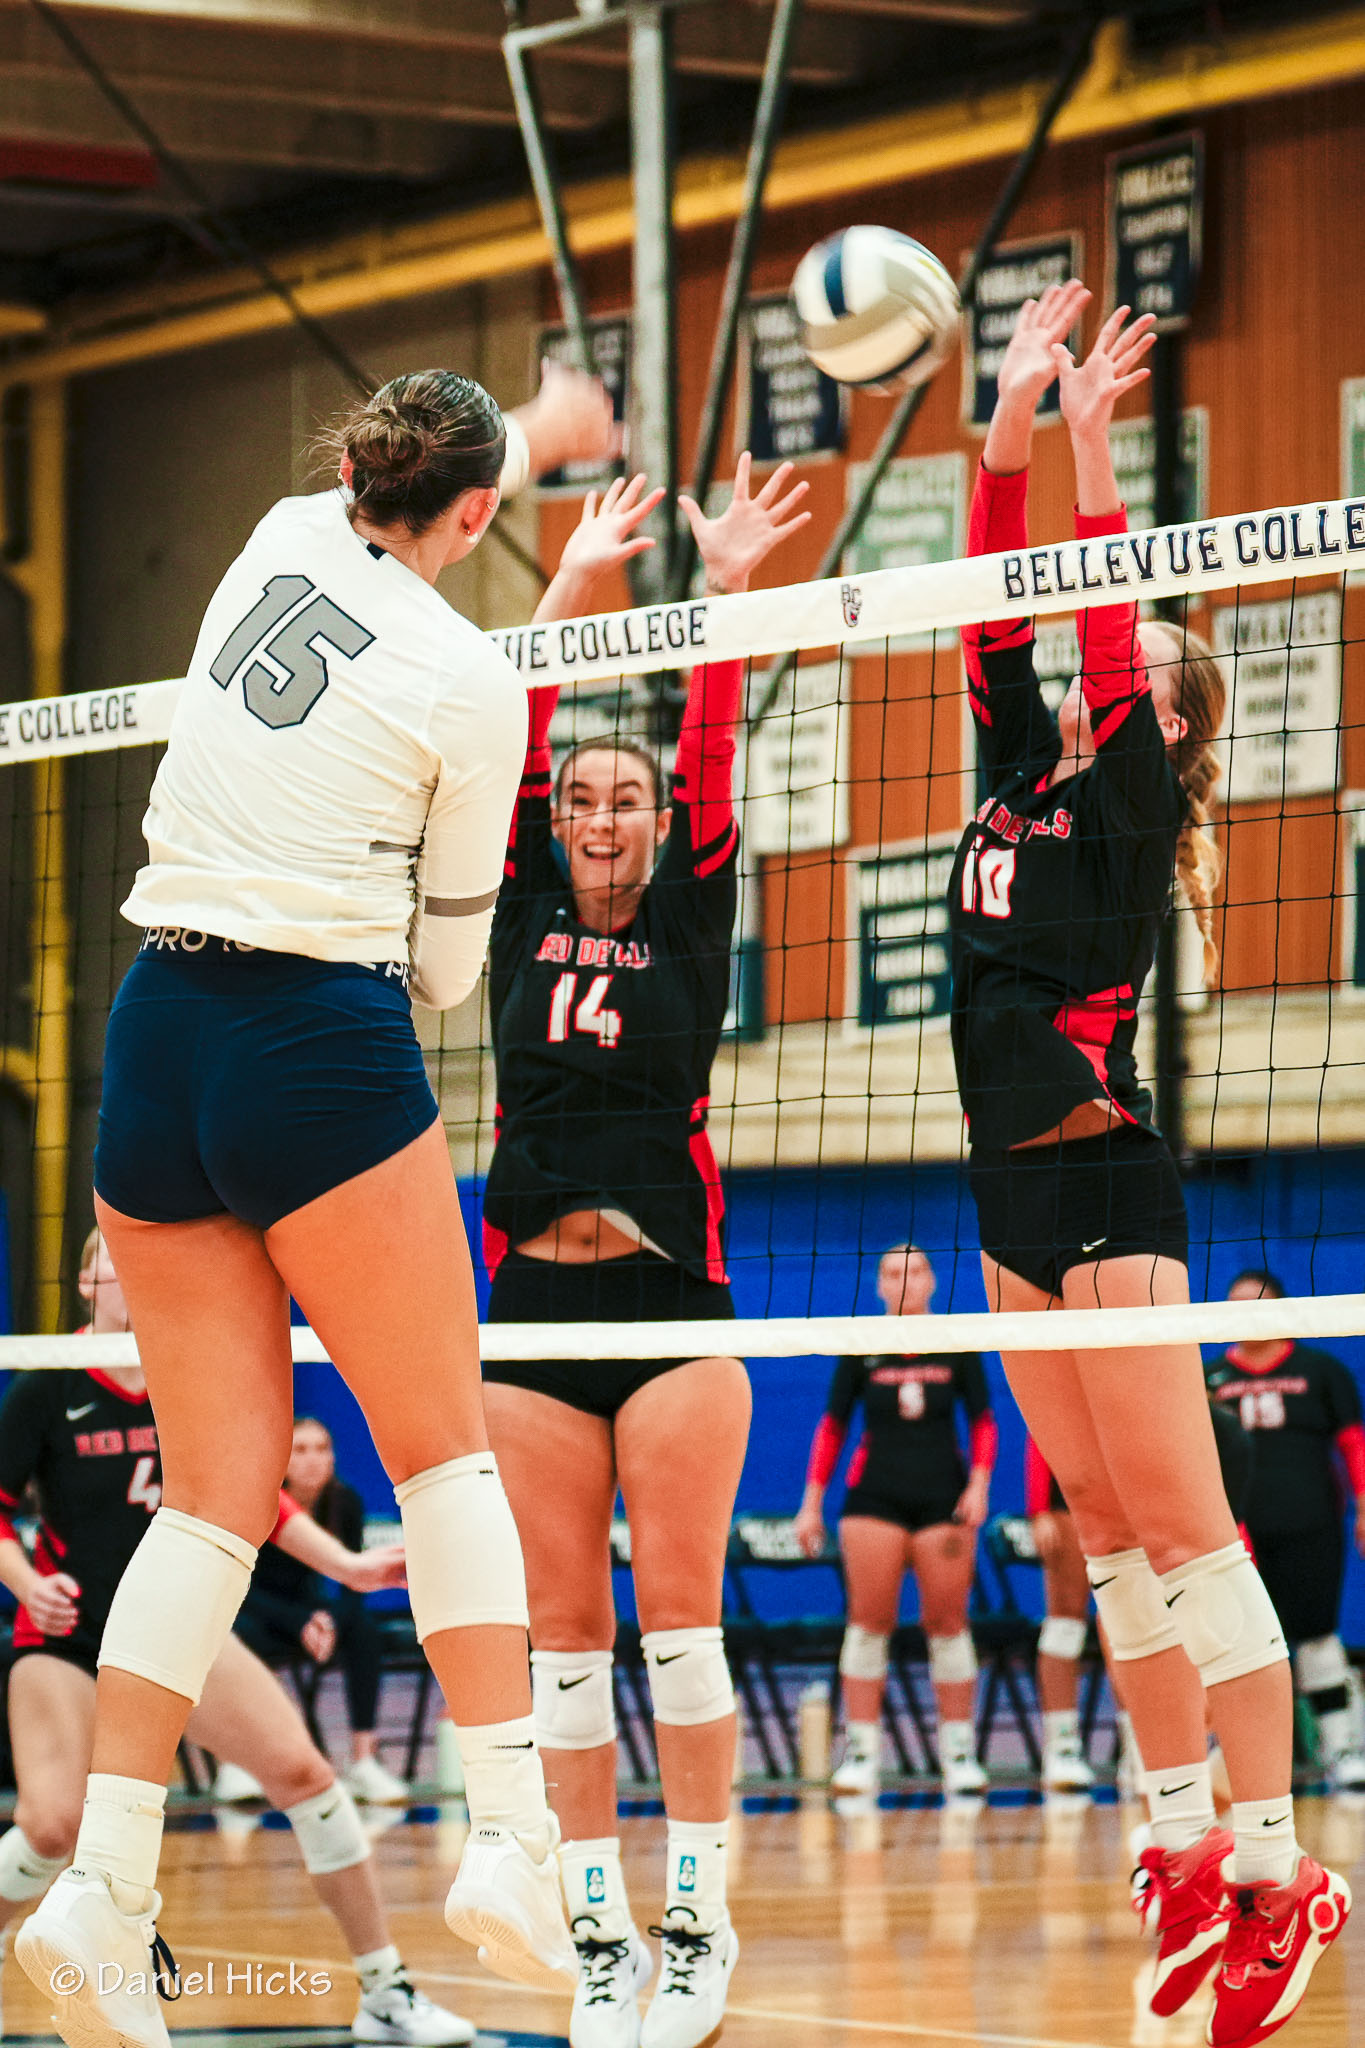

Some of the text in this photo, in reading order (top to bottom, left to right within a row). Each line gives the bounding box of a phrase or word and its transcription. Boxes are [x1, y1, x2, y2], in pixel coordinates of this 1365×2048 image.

[1003, 501, 1365, 601] BELLEVUE COLLE
[209, 574, 378, 730] 15
[560, 605, 708, 665] COLLEGE
[19, 692, 138, 743] COLLEGE
[961, 834, 1017, 920] 10
[547, 971, 623, 1049] 14
[127, 1457, 163, 1513] 4
